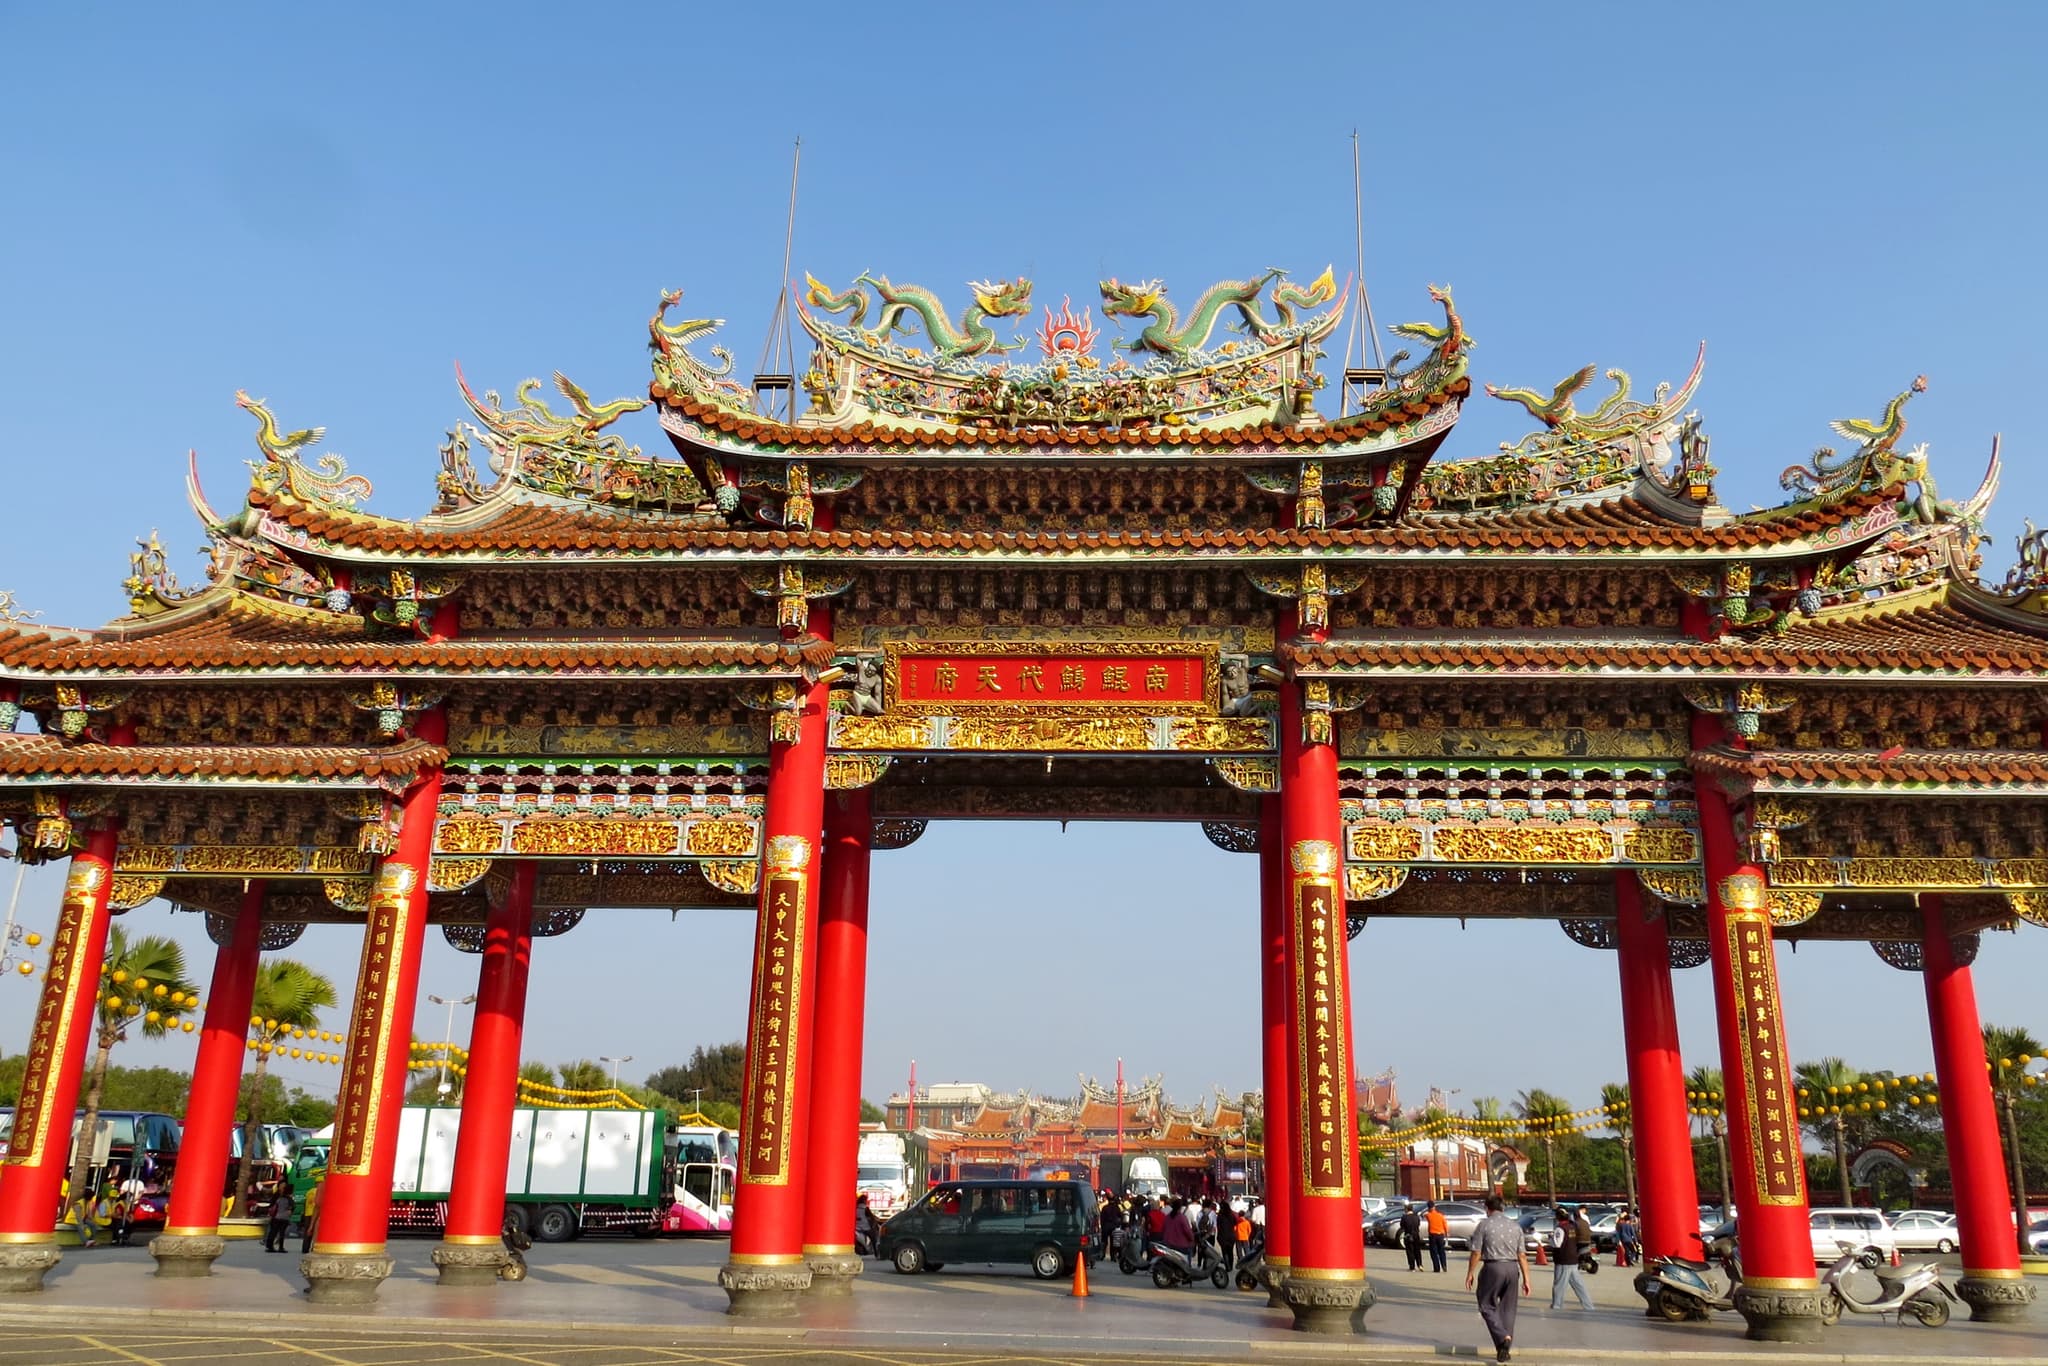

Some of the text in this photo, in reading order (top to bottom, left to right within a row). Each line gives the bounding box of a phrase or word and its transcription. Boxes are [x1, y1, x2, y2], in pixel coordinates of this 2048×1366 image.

[933, 662, 1169, 693] 南鯤鯓代天府
